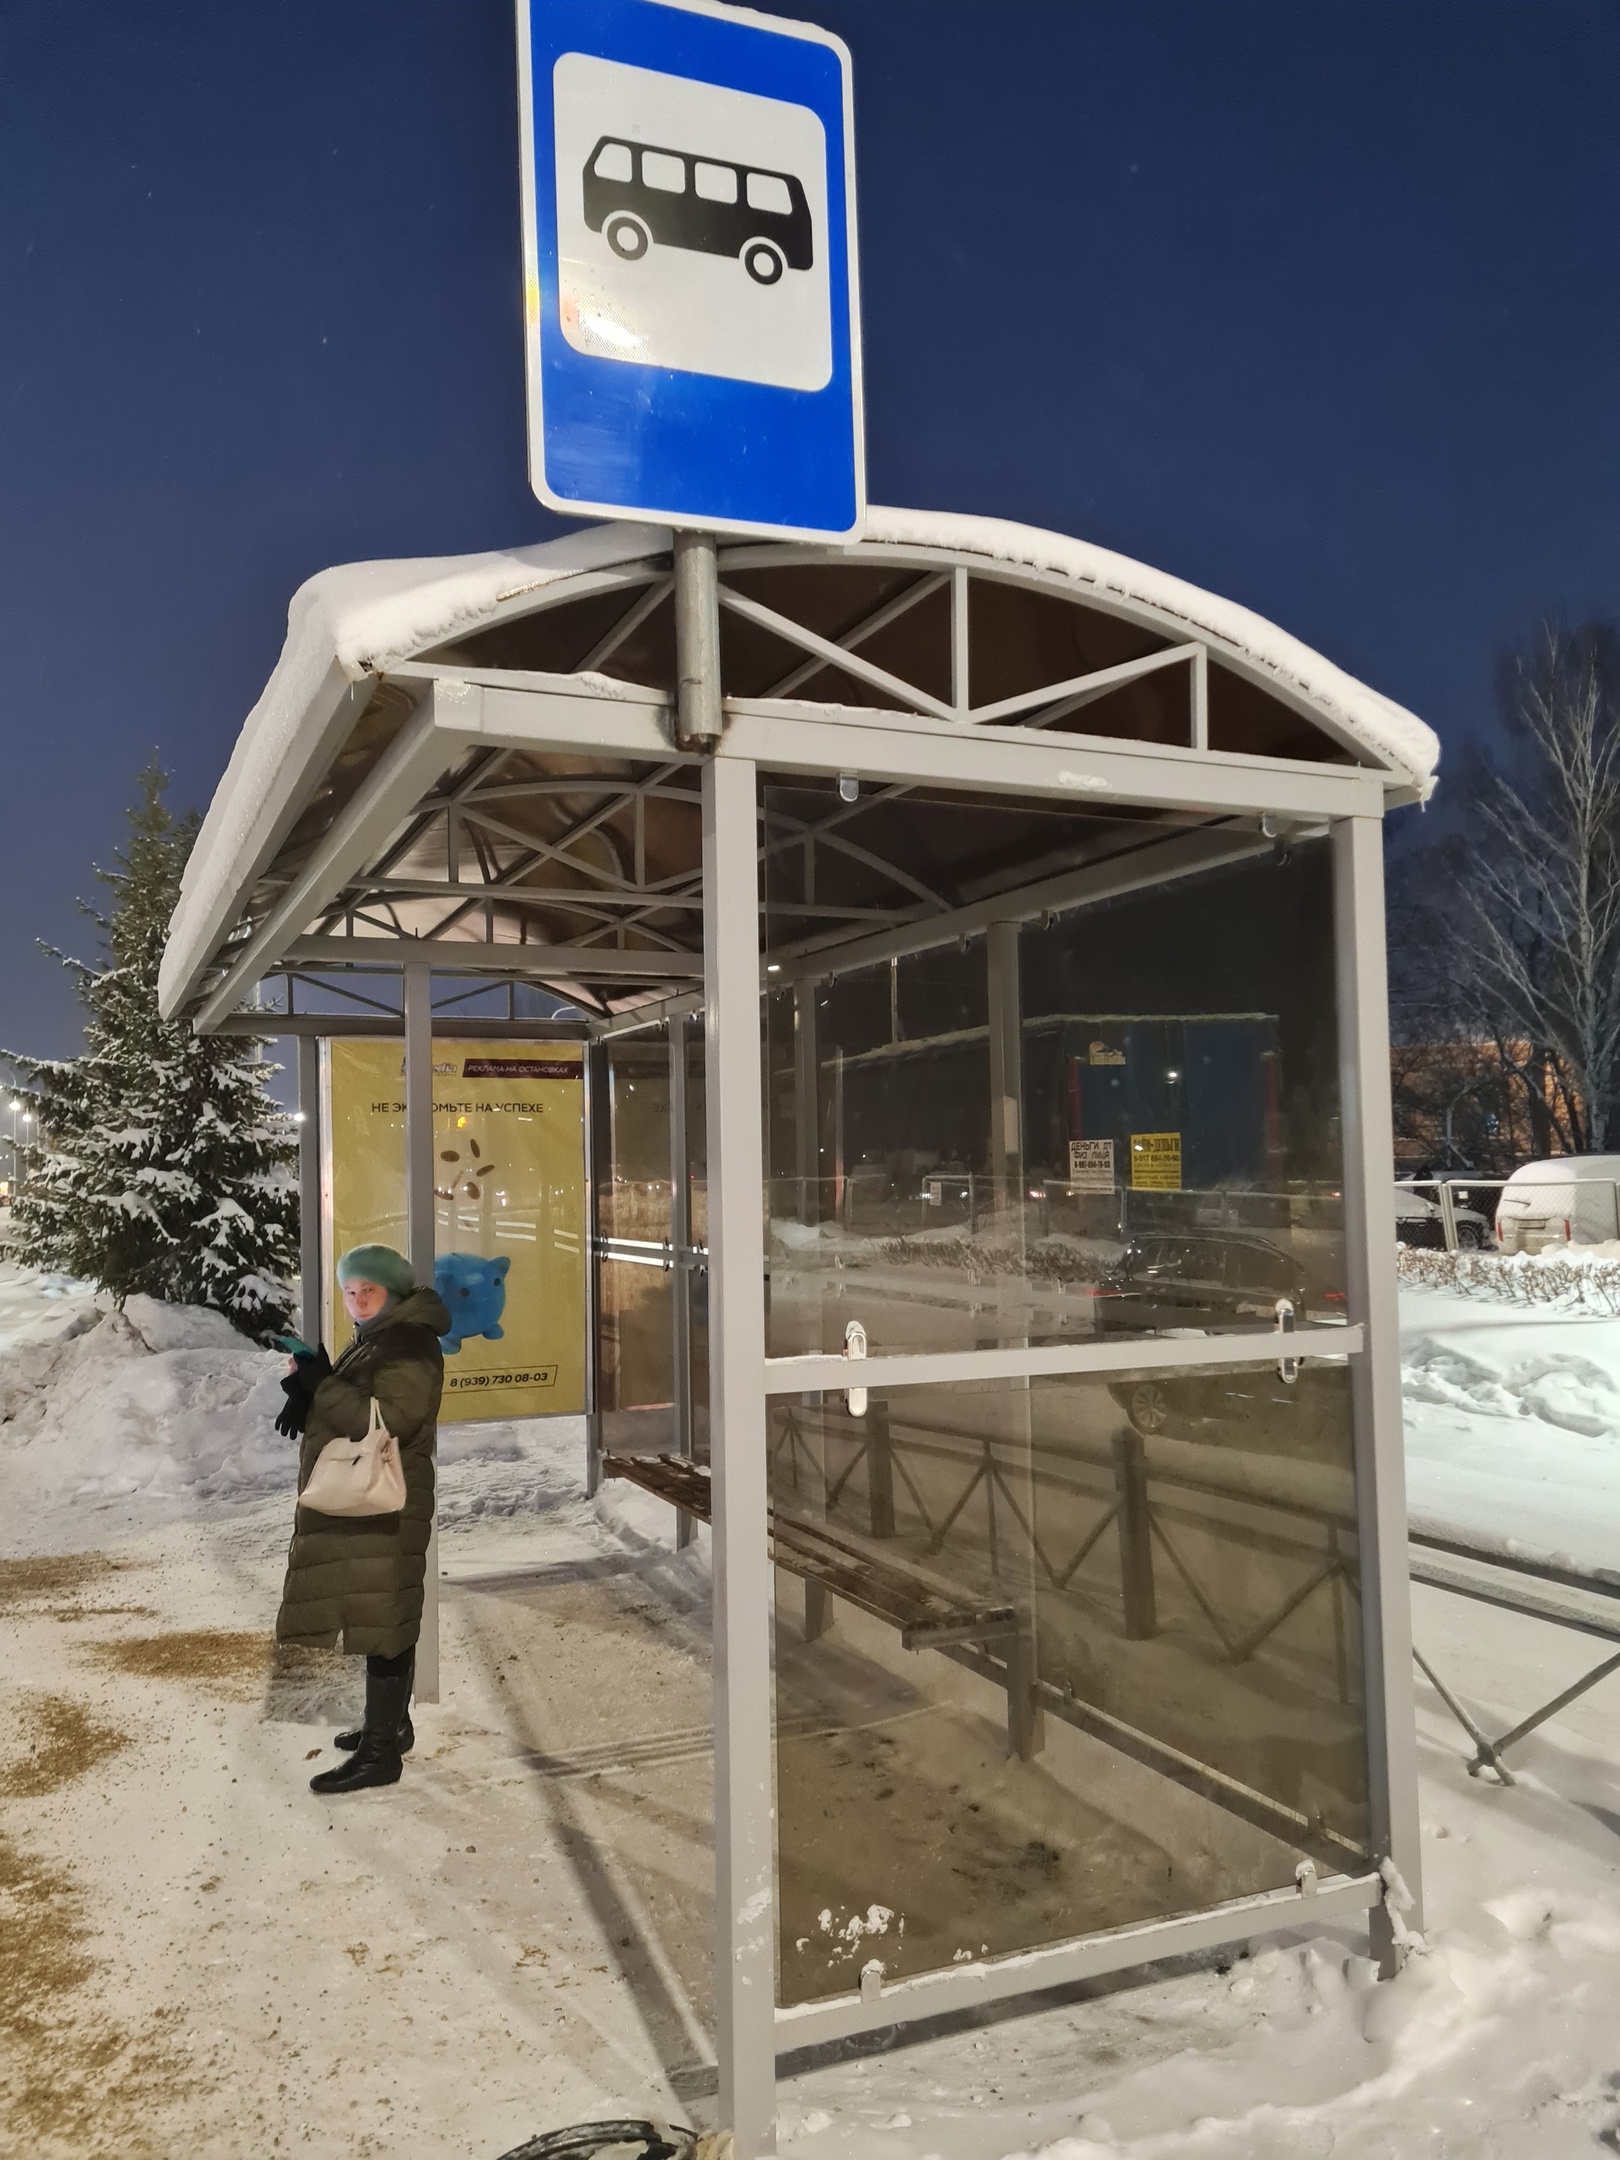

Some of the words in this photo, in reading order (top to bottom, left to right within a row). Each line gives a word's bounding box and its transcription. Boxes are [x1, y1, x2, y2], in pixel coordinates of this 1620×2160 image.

[467, 1064, 505, 1073] РЕКЛАМА
[505, 1065, 517, 1073] НА
[518, 1065, 569, 1074] ОСТАНОВКАХ
[372, 1103, 390, 1113] НЕ
[392, 1103, 473, 1113] ЭКОМЬТЕ
[476, 1103, 493, 1113] НА
[496, 1103, 544, 1113] УСПЕХЕ
[1071, 1141, 1099, 1151] ДЕНЬГИ
[450, 1378, 458, 1387] 8
[460, 1376, 490, 1388] (939)
[491, 1374, 513, 1384] 730
[515, 1373, 548, 1383] 08-03
